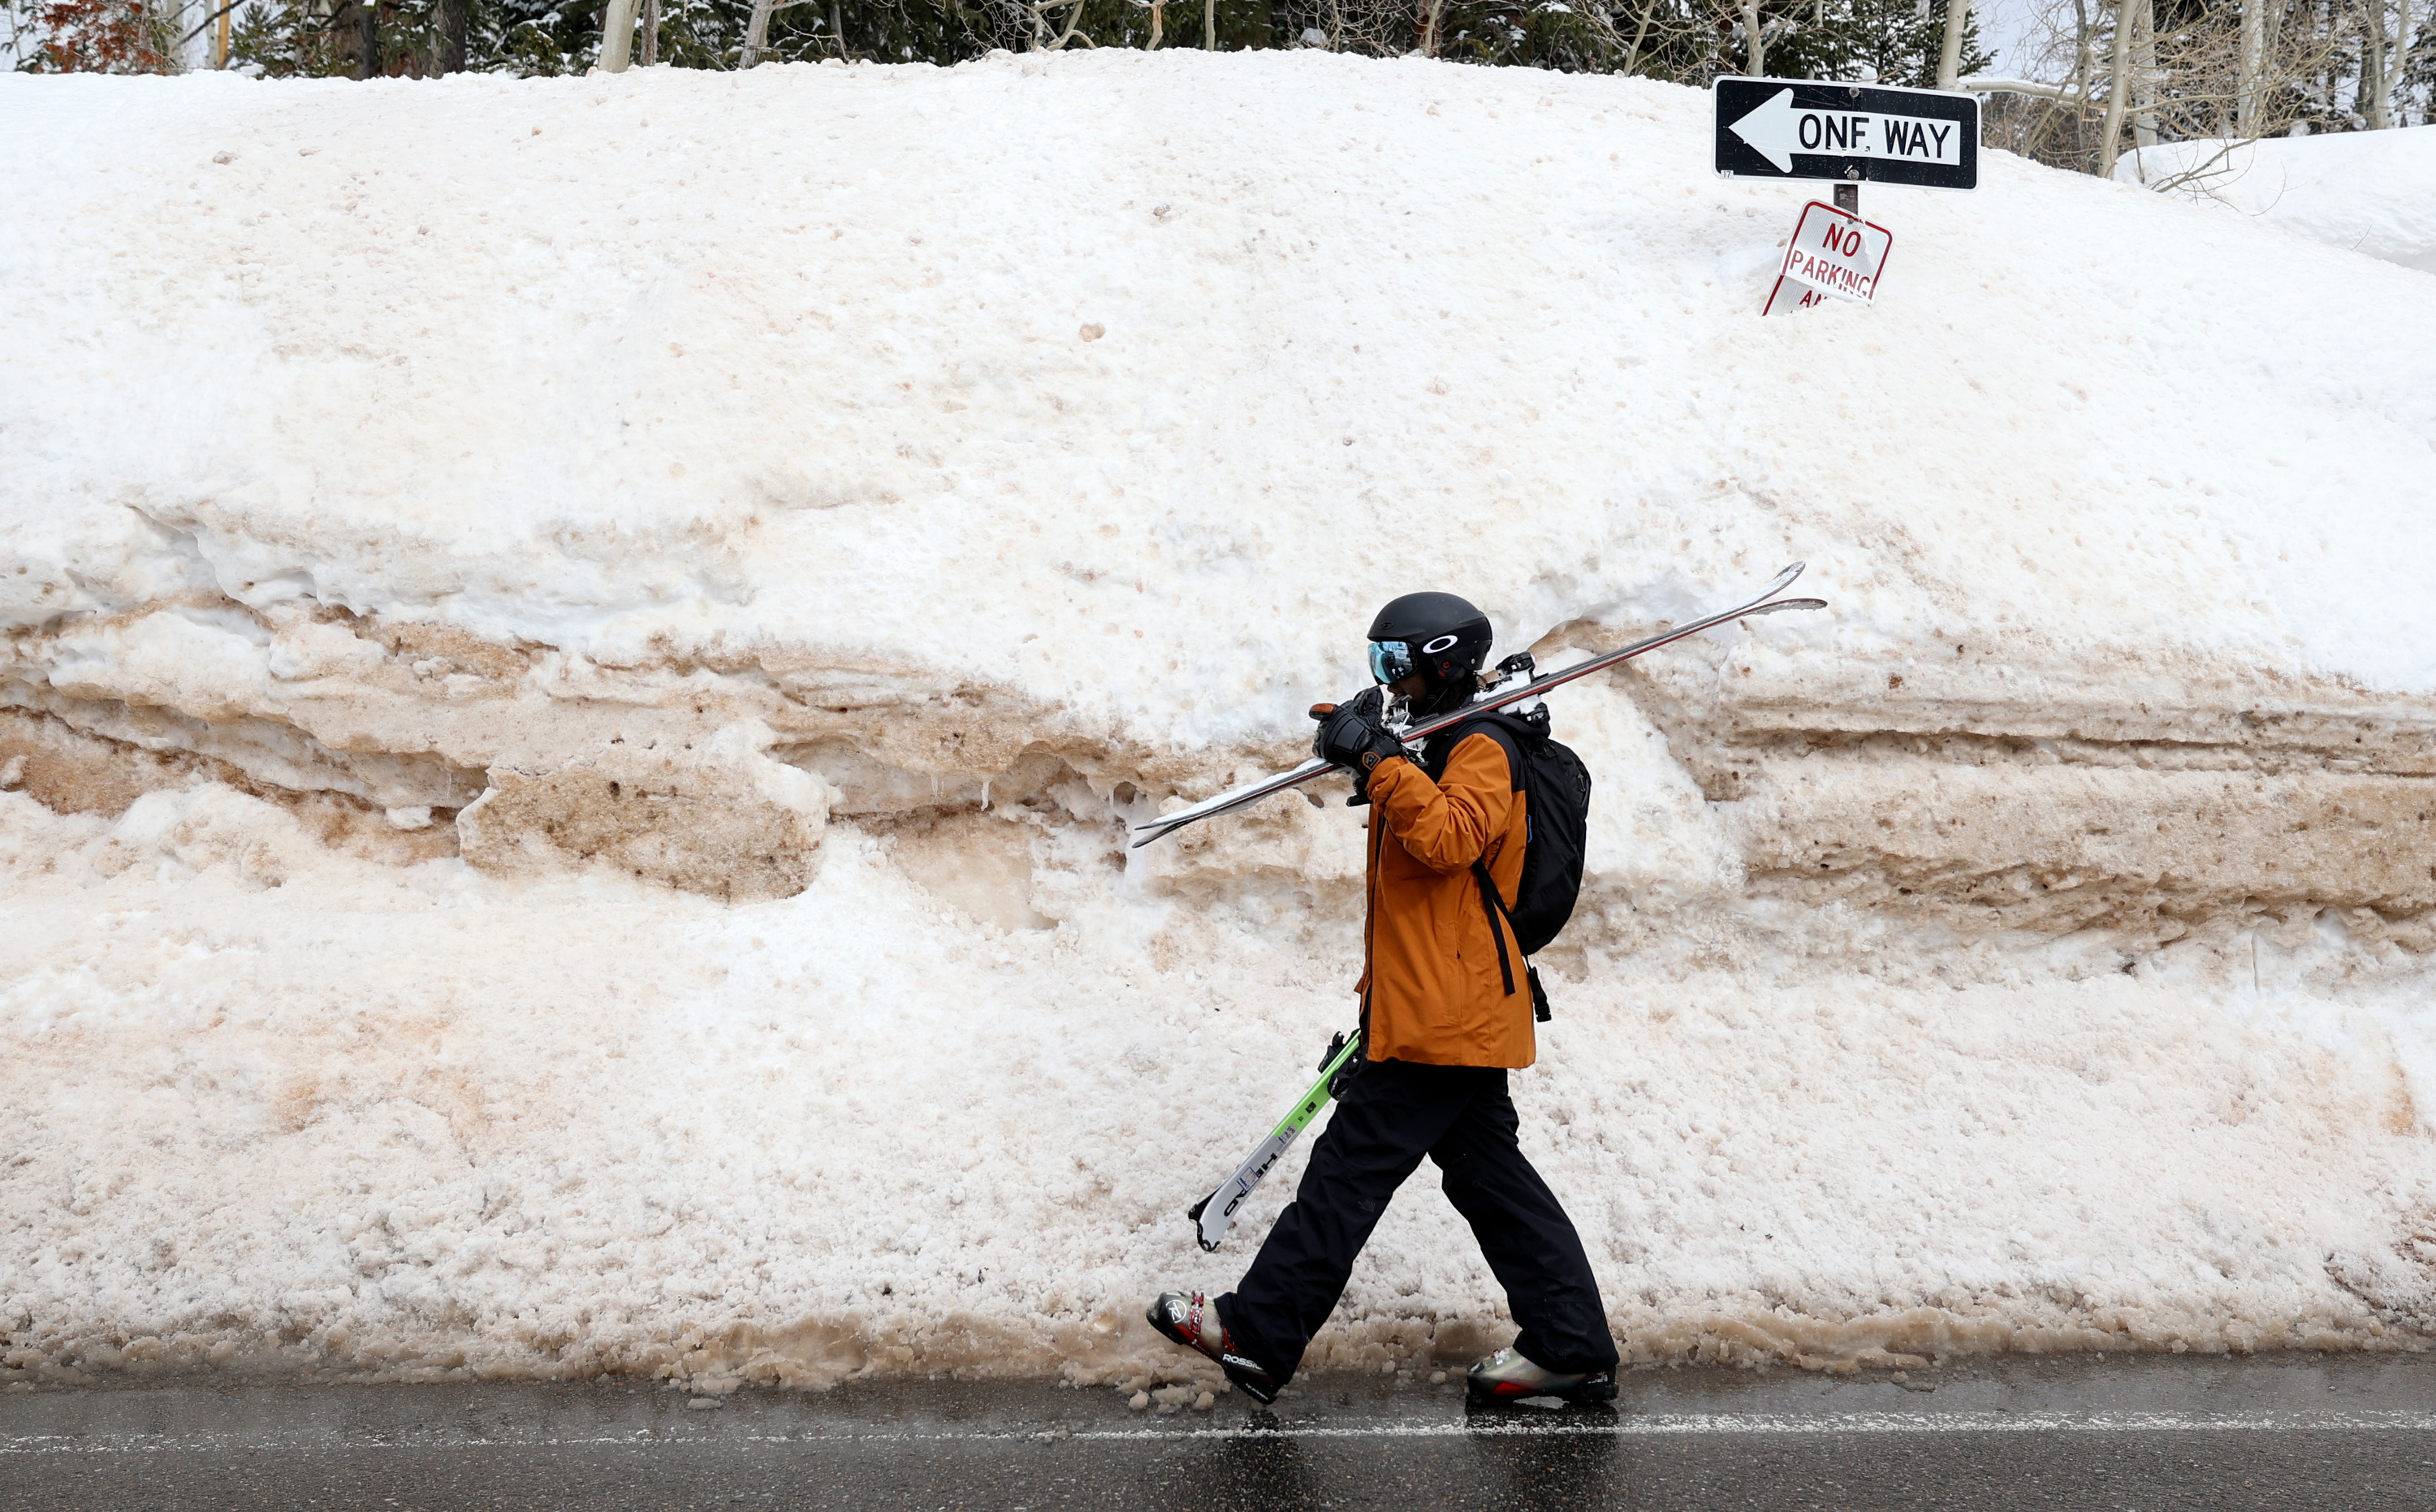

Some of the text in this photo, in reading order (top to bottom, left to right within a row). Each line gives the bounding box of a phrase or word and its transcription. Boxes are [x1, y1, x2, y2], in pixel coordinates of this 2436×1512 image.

[1884, 119, 1951, 158] WAY
[1822, 222, 1861, 257] NO
[1789, 249, 1870, 298] PARKING
